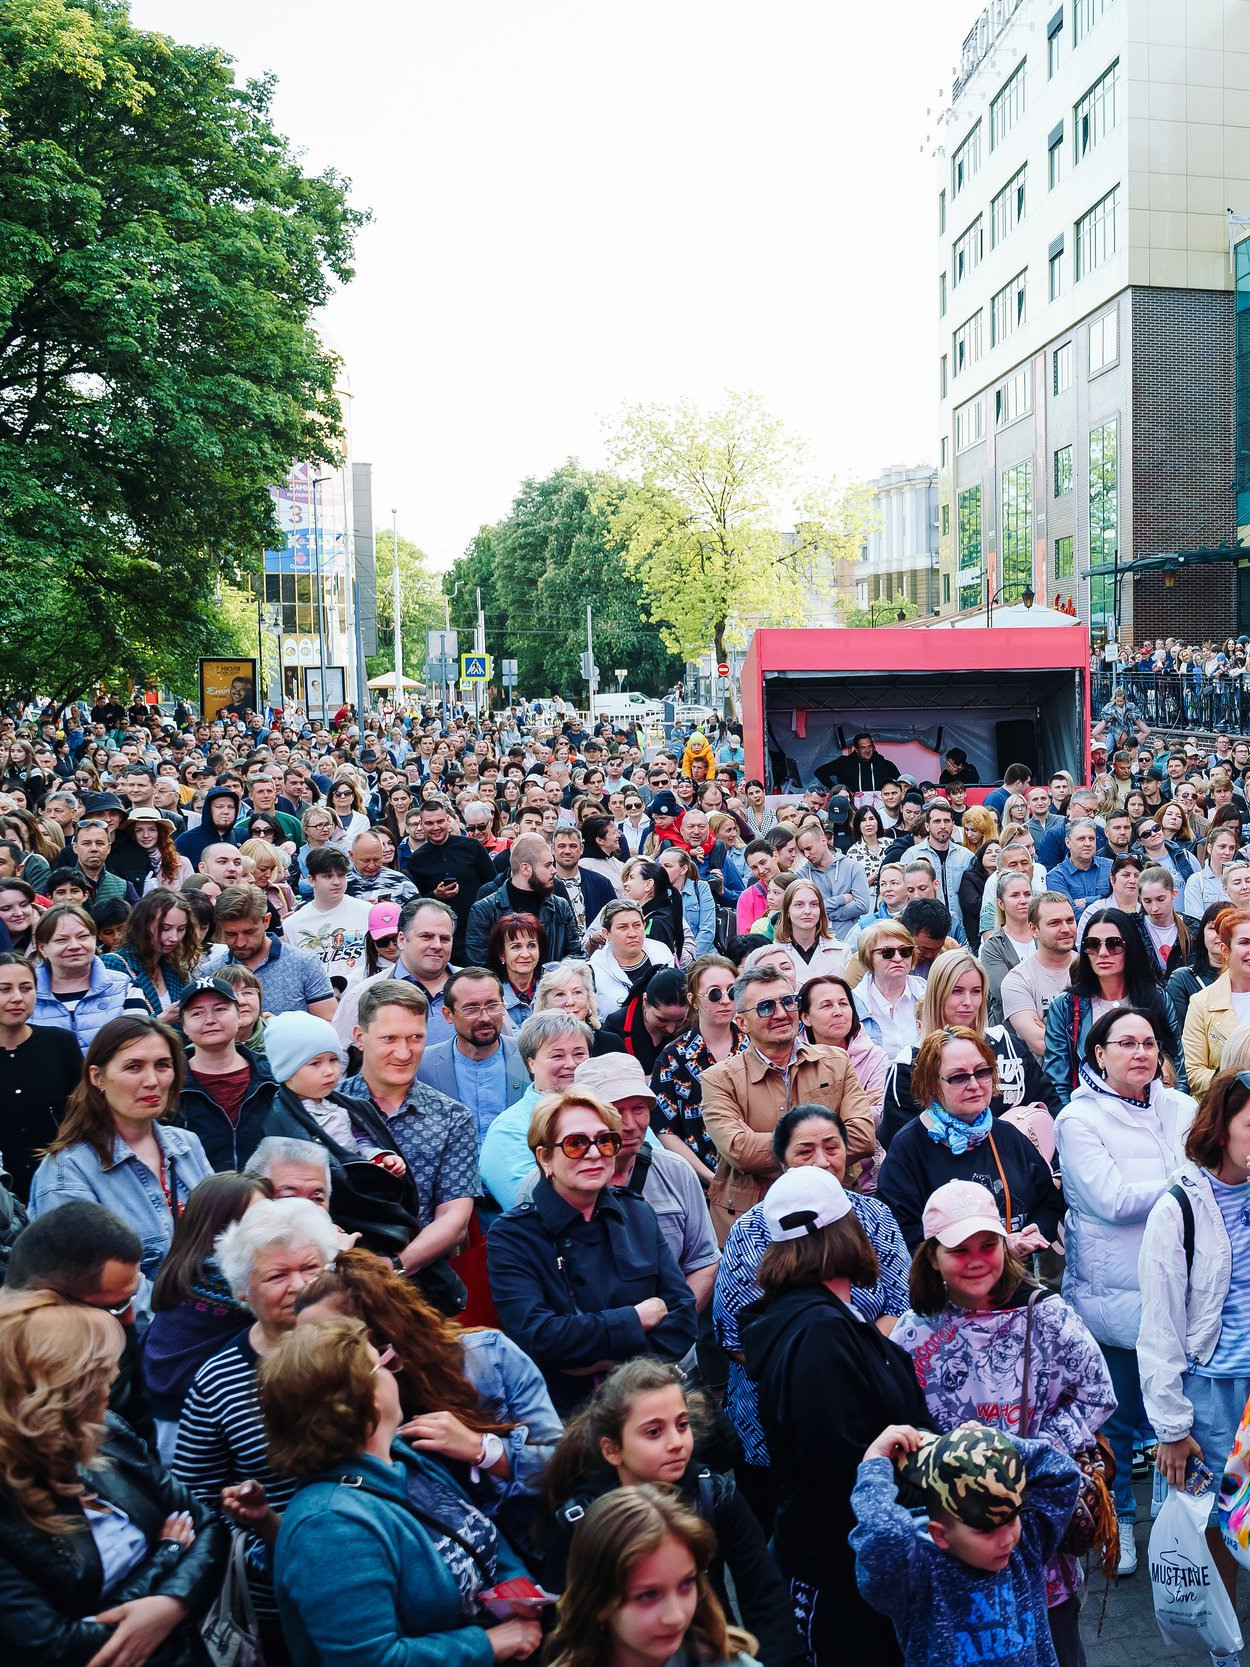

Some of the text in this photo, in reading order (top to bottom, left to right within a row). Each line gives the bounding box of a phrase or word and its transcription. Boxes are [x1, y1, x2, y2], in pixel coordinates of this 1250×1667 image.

[288, 505, 304, 525] 3
[195, 976, 215, 990] NY
[1165, 1577, 1198, 1604] Store
